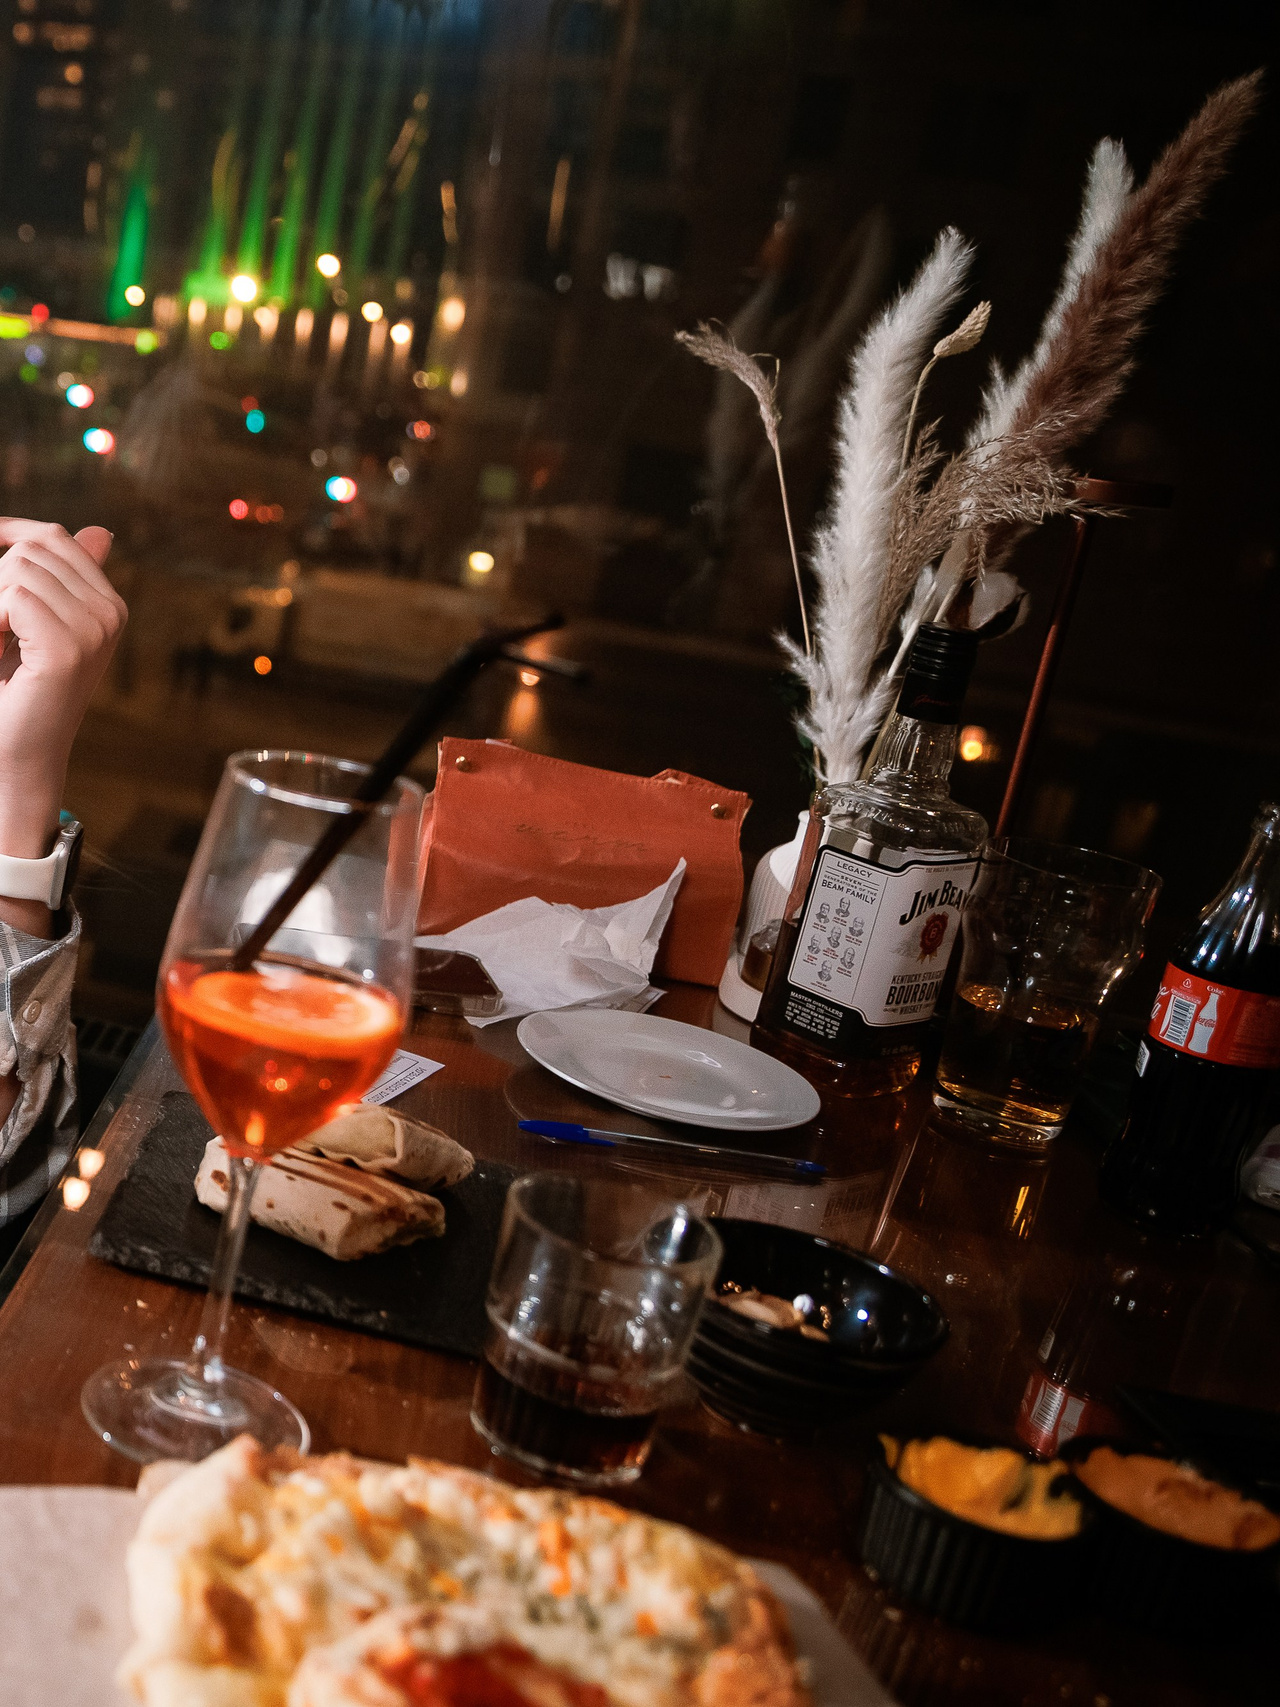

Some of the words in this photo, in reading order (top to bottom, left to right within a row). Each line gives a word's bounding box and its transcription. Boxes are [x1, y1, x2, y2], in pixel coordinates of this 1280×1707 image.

[836, 861, 873, 878] LEGACY
[840, 875, 862, 886] SEVEN
[821, 879, 844, 892] BEAM
[845, 888, 876, 905] FAMILY
[898, 888, 940, 926] JIM
[891, 973, 921, 985] KENTUCKY
[790, 990, 813, 1003] MASTER
[811, 1000, 844, 1018] DISTILLERS
[885, 981, 942, 1005] BOURBON
